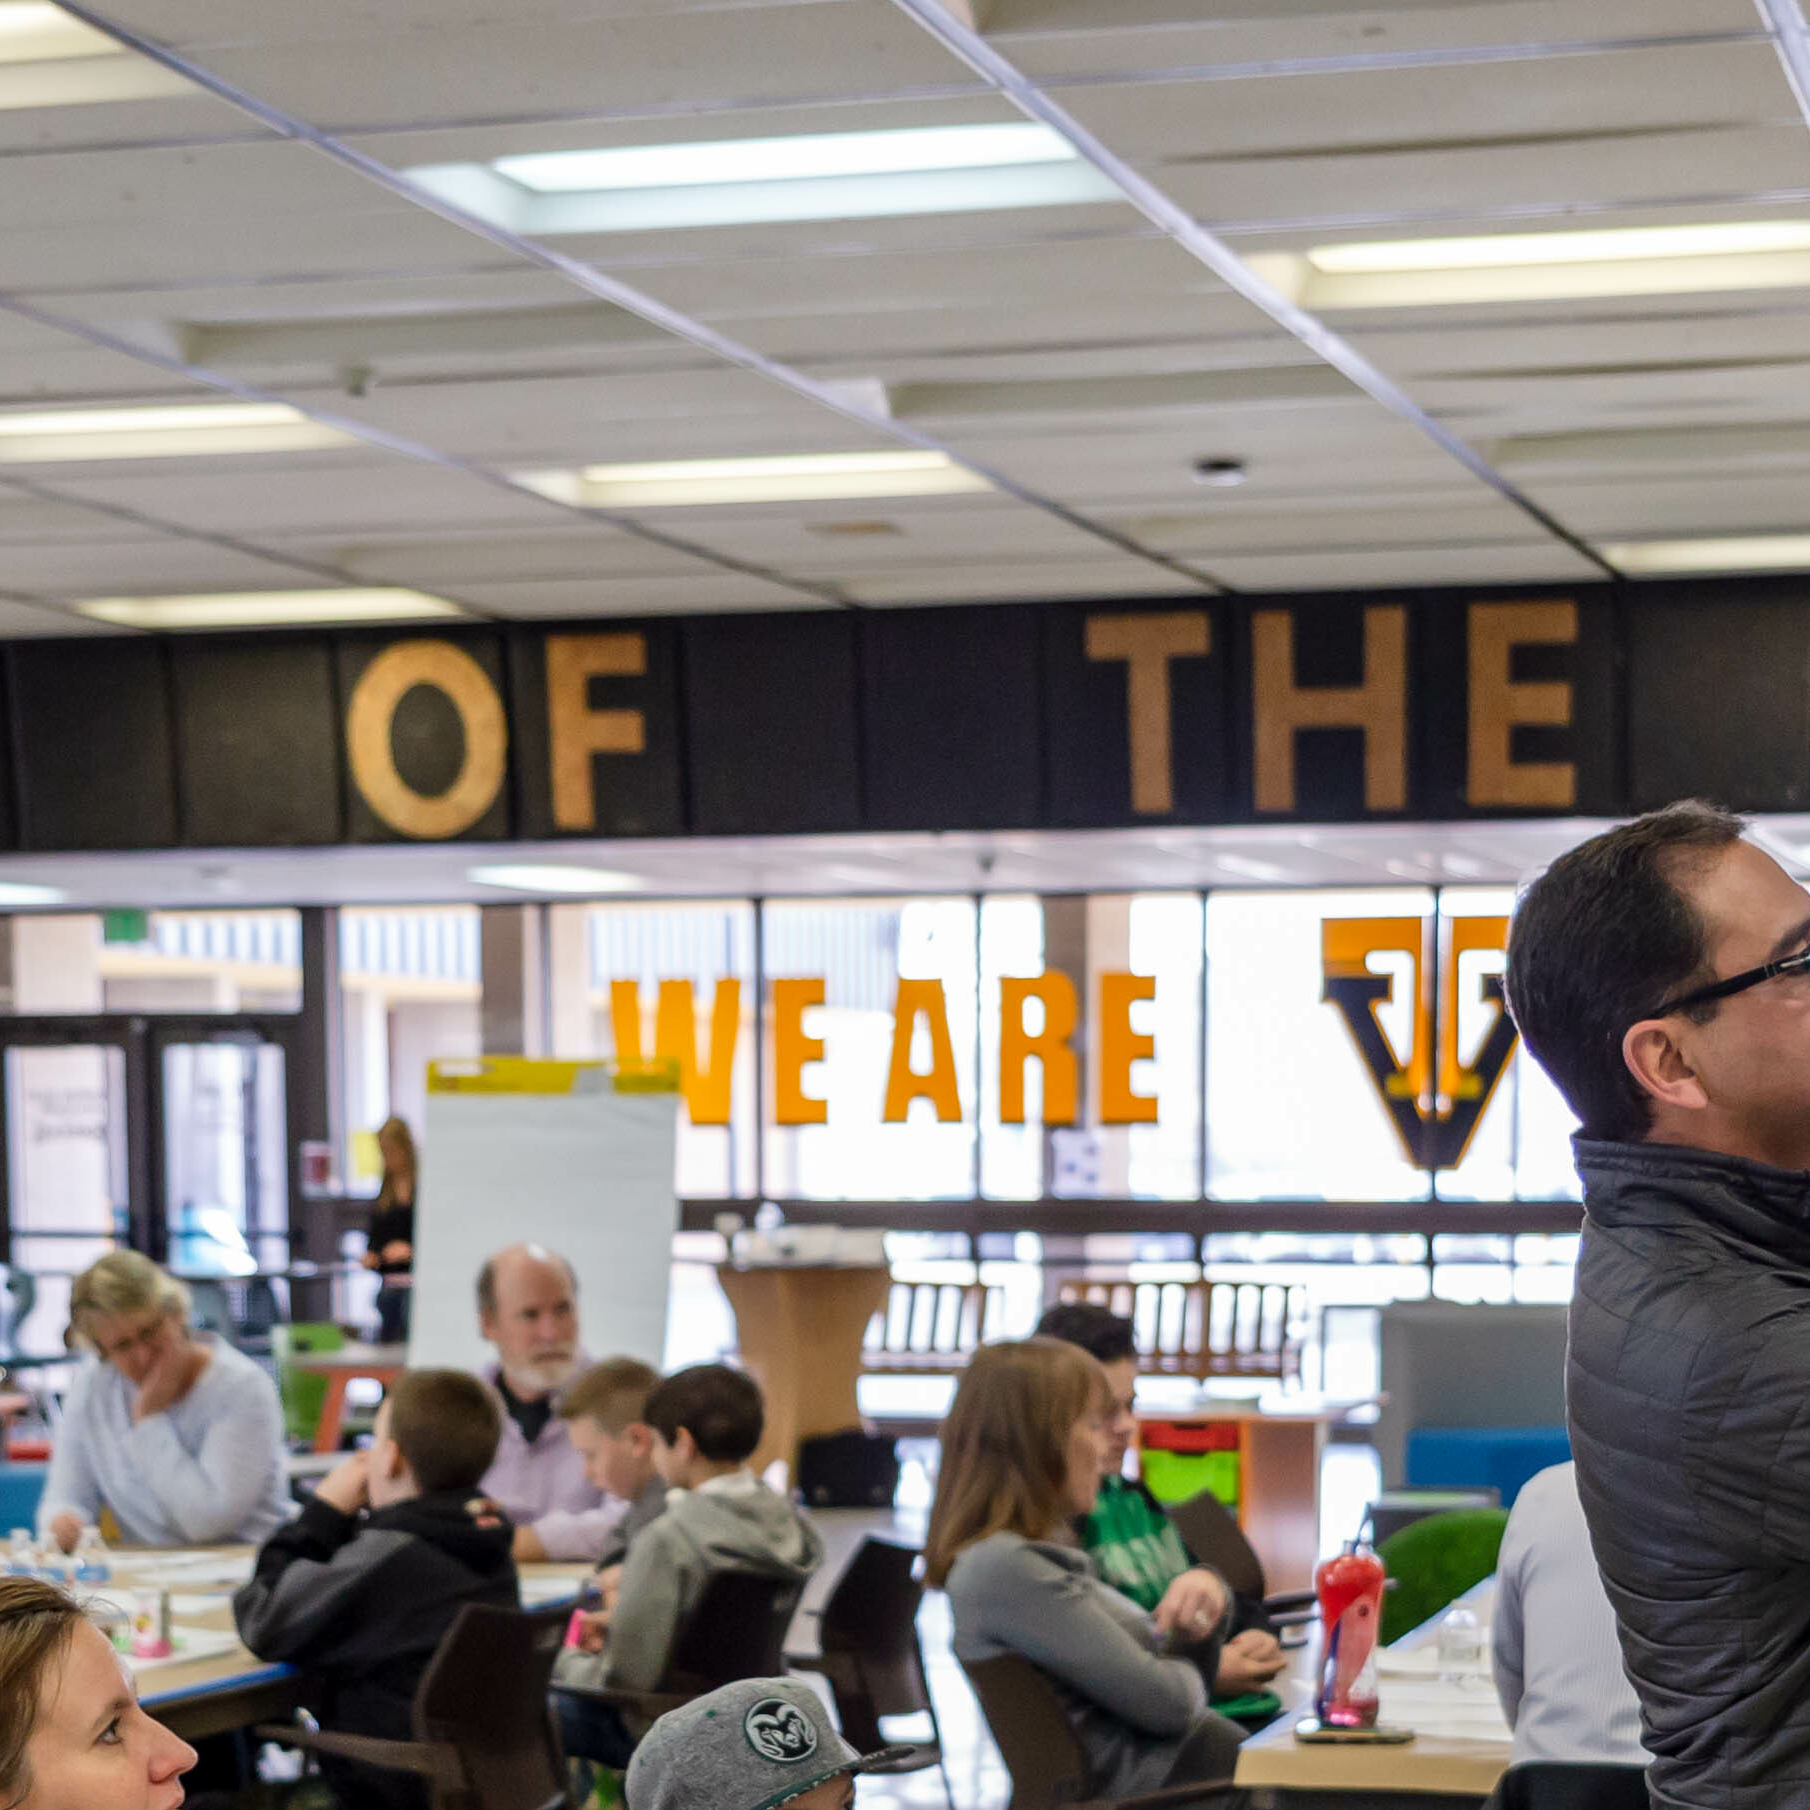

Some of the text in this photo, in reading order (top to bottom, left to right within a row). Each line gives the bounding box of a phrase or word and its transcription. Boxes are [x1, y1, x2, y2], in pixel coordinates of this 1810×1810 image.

[346, 633, 648, 840] OF
[1085, 601, 1580, 815] THE
[609, 970, 1160, 1126] WE ARE
